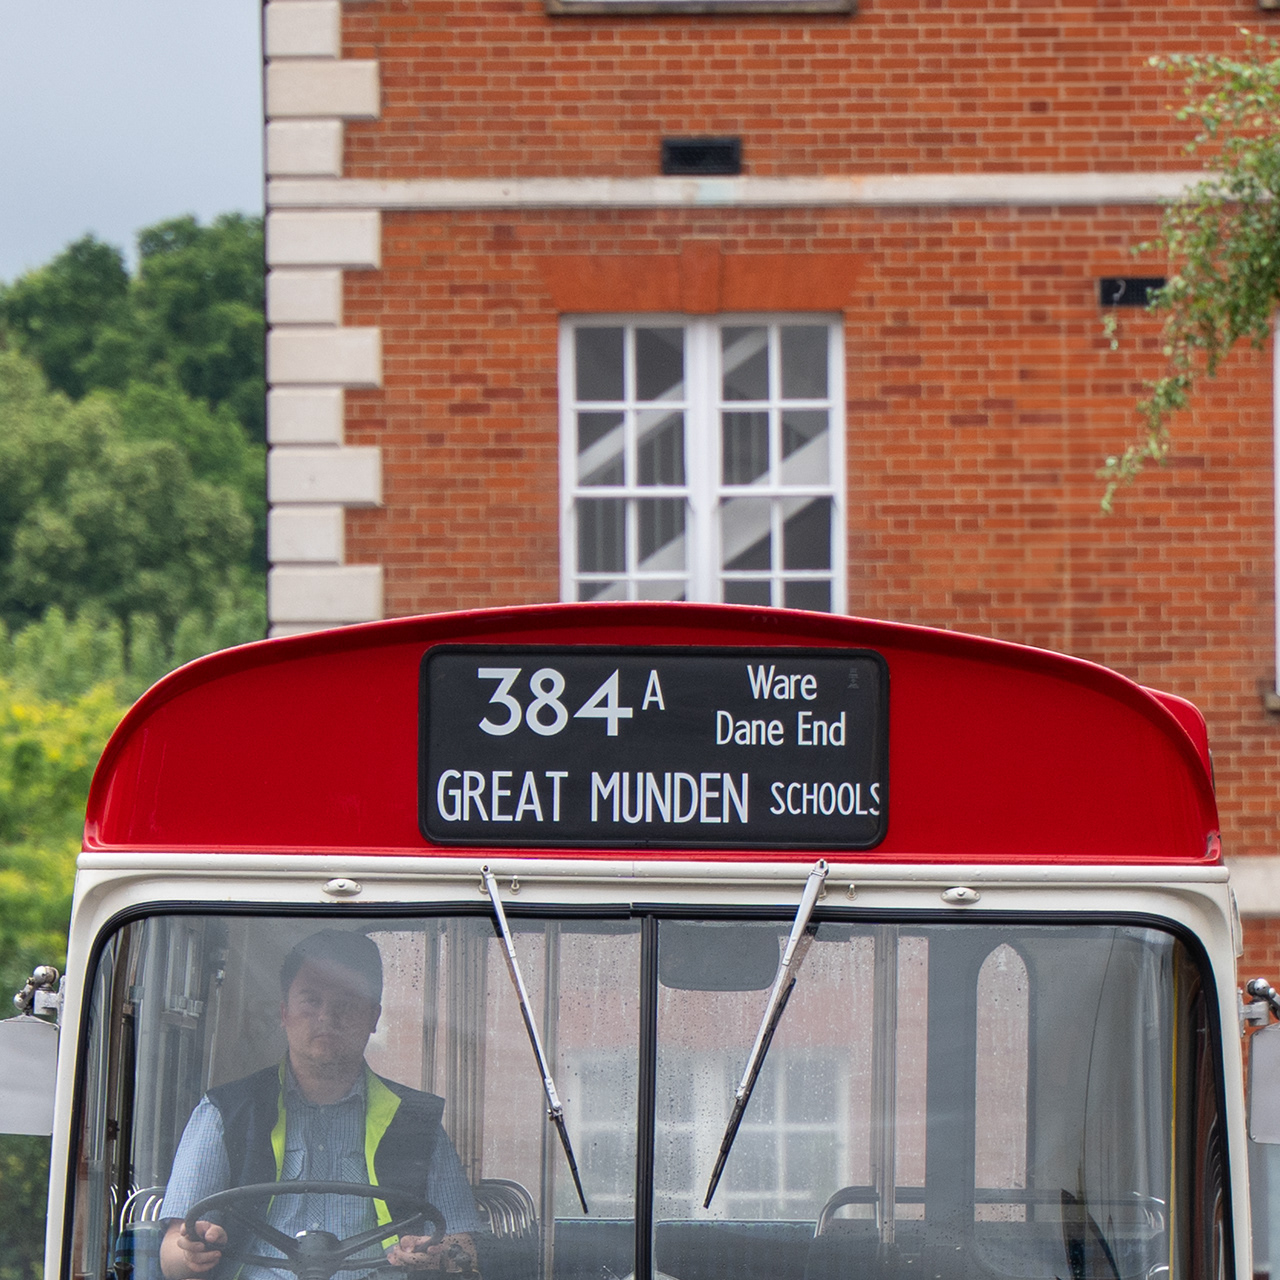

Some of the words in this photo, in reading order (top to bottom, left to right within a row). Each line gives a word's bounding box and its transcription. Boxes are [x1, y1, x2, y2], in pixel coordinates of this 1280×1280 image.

[746, 664, 818, 700] Ware
[716, 710, 784, 746] Dane
[797, 710, 846, 747] End
[437, 769, 569, 822] GREAT
[591, 771, 749, 824] MUNDEN
[770, 781, 880, 816] SCHOOLS
